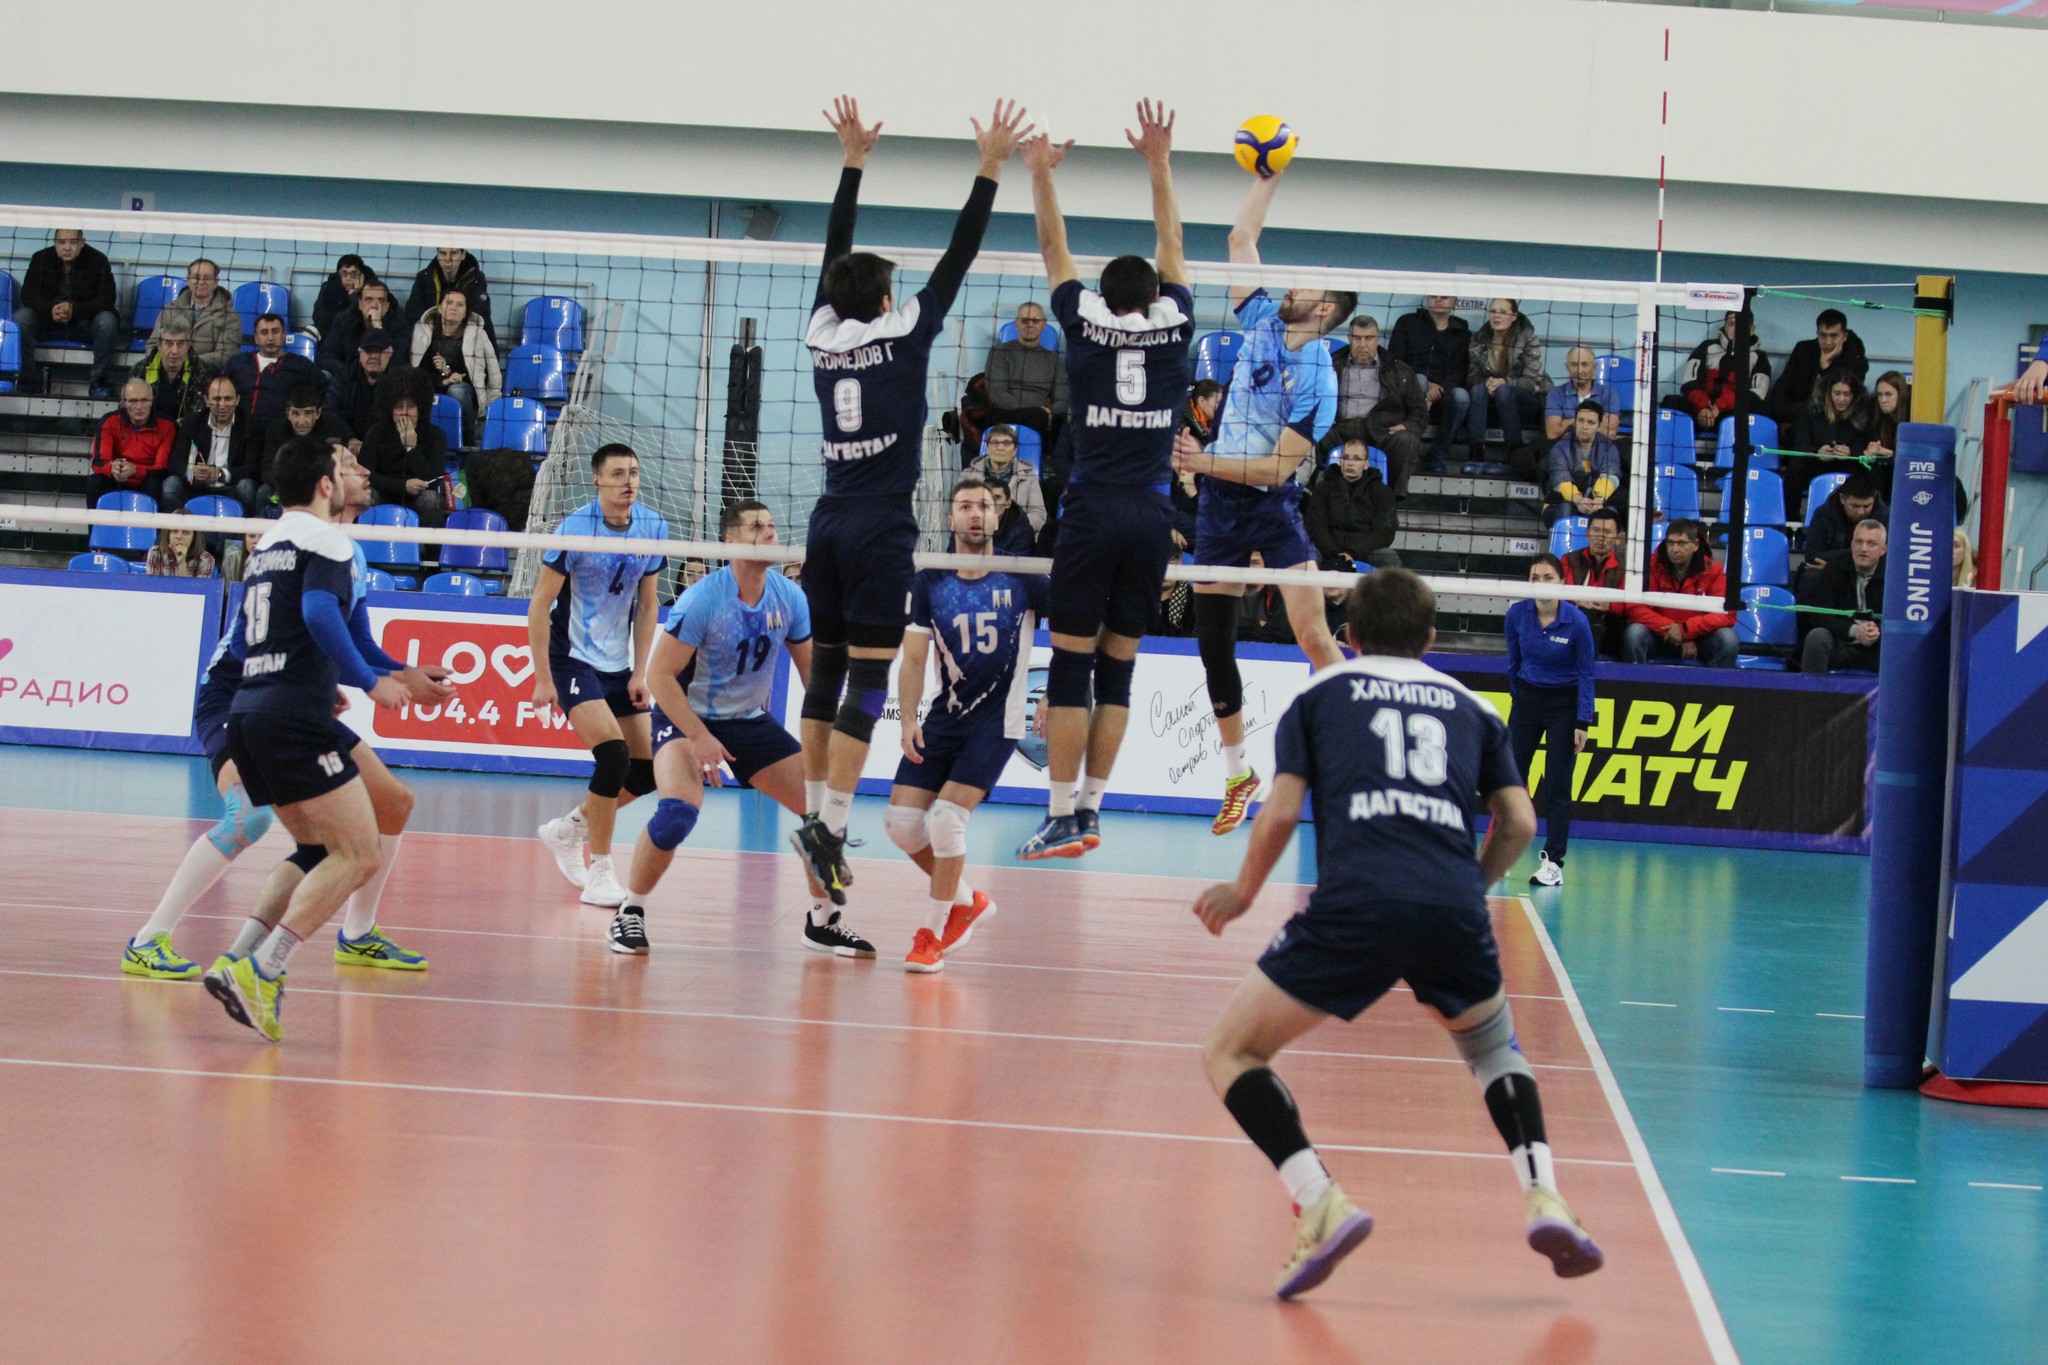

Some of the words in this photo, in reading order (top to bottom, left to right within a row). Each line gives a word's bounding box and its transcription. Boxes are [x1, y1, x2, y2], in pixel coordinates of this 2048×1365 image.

[1115, 349, 1147, 406] 5
[834, 377, 863, 432] 9
[1085, 404, 1173, 429] ДАГЕСТАН
[1909, 461, 1936, 472] FIVB
[1515, 486, 1530, 495] РЯД
[1515, 542, 1530, 551] РЯД
[608, 560, 626, 596] 4
[1906, 522, 1934, 622] JINLING
[243, 582, 273, 647] 15
[952, 611, 999, 655] 15
[736, 634, 772, 675] 19
[0, 677, 130, 708] РАДИО
[1350, 678, 1457, 711] ХАТИПОВ
[317, 750, 345, 778] 15
[1368, 707, 1449, 787] 13
